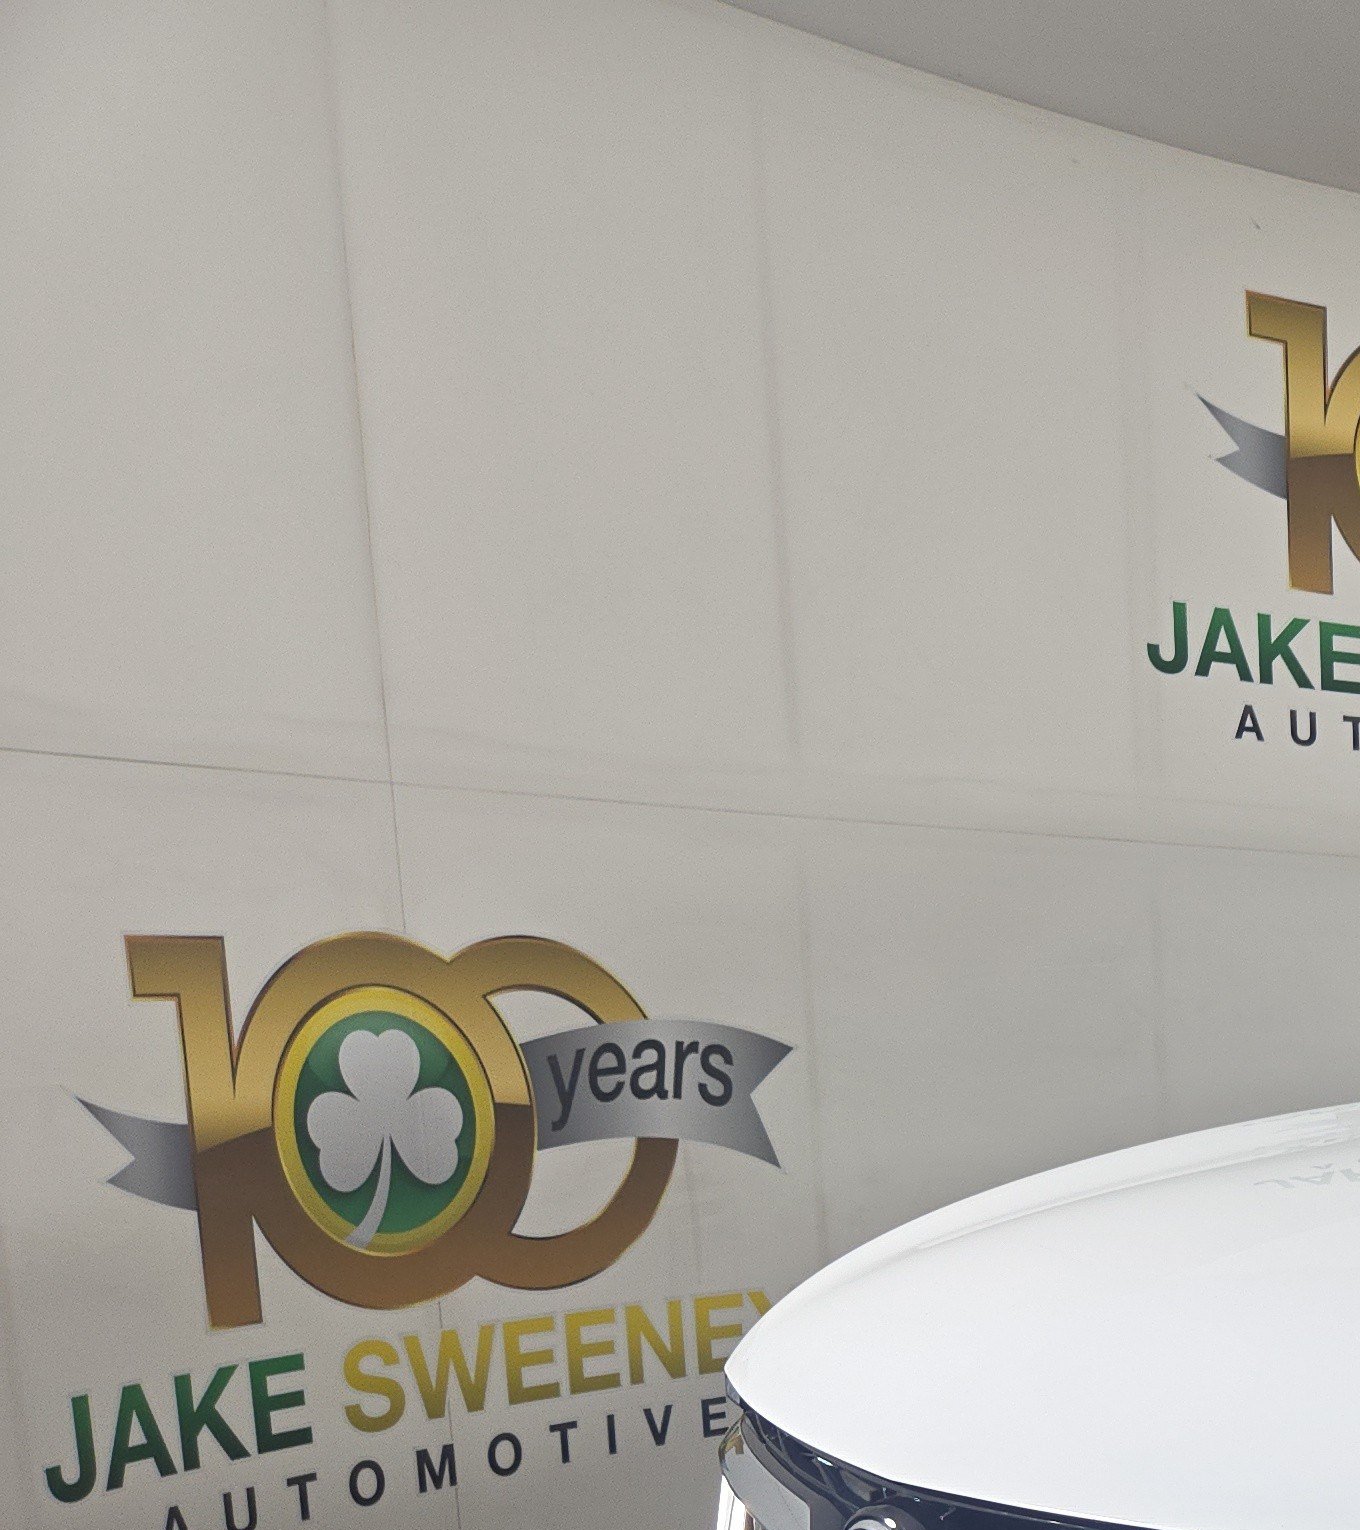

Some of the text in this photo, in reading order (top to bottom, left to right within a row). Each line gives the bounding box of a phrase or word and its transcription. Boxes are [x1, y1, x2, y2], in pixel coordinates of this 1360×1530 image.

[126, 932, 735, 1330] 100 years
[44, 1354, 314, 1503] JAKE
